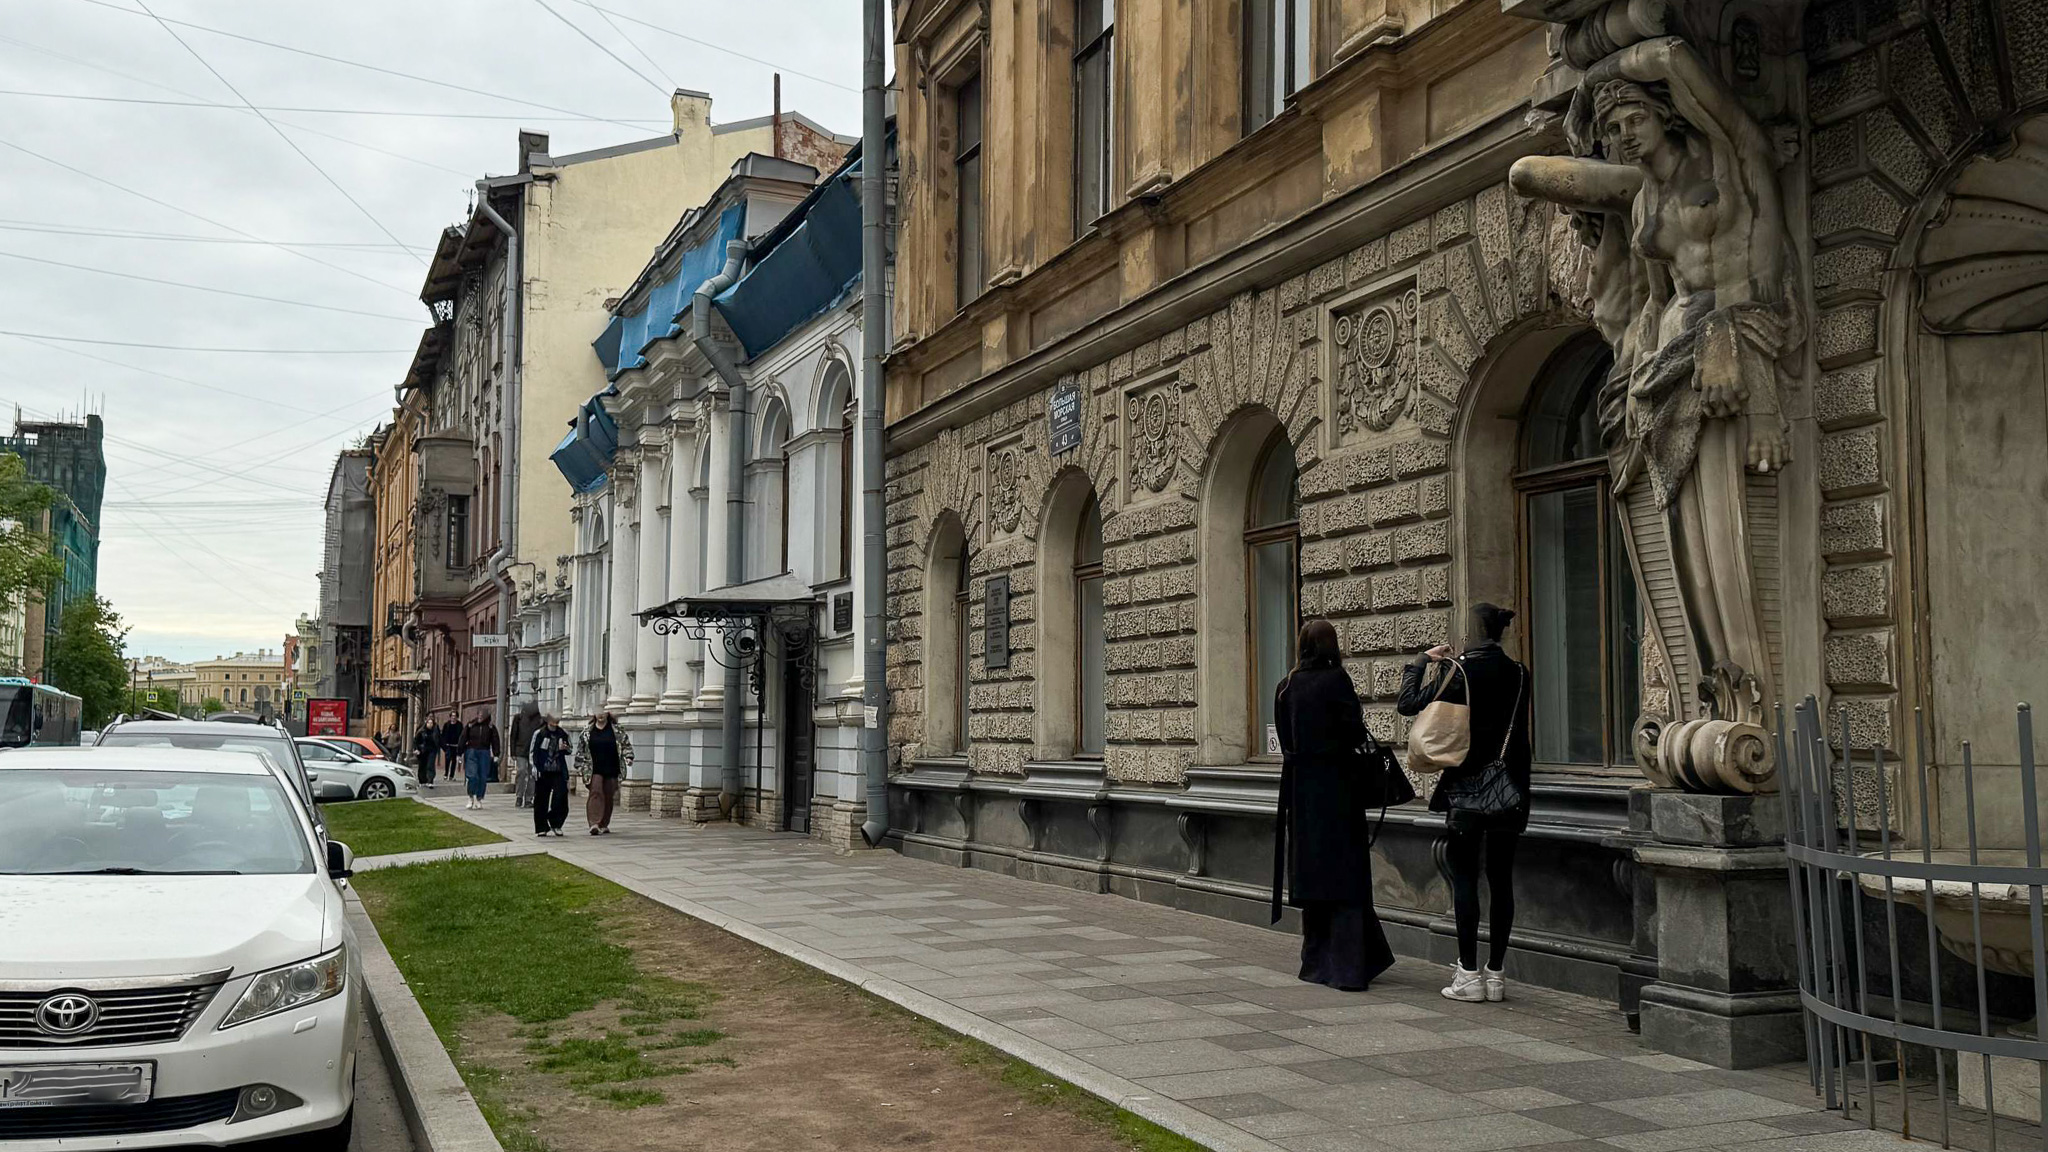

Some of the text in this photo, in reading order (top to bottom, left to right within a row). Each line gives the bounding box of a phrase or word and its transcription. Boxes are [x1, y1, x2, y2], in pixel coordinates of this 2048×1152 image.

[1053, 391, 1076, 410] БОЛЬШАЯ
[1053, 402, 1075, 420] МОРСКАЯ
[1061, 433, 1068, 447] 43
